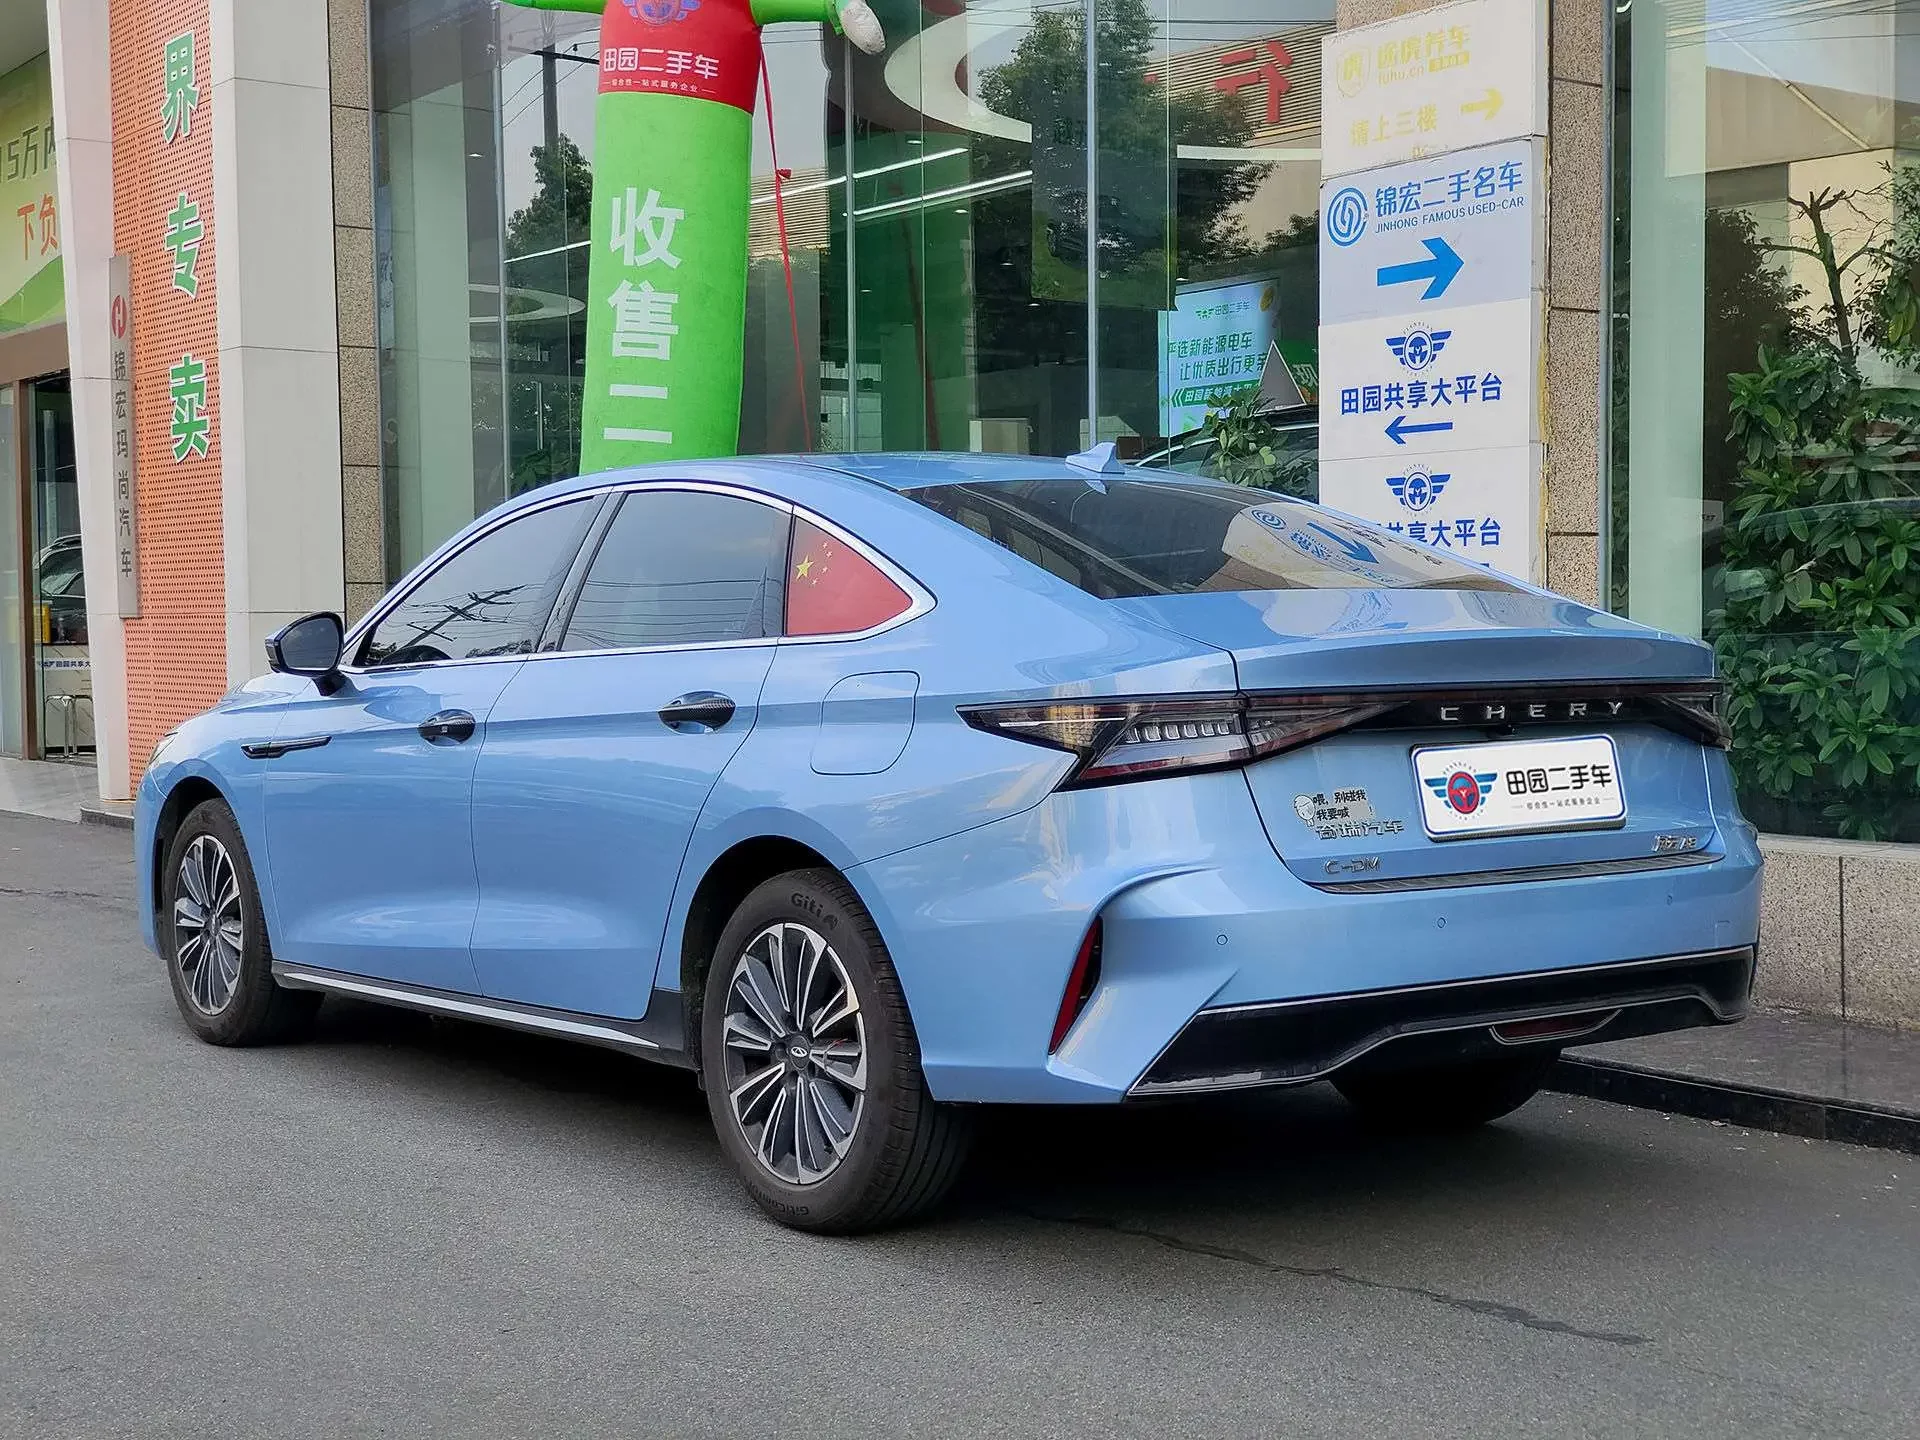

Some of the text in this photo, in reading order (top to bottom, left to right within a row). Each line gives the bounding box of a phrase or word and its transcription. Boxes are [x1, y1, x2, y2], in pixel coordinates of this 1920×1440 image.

[603, 47, 720, 79] 田园二手车
[1375, 161, 1523, 217] 锦宏二手名车
[1375, 196, 1524, 234] JINHONG FAMOUS USED-CAR
[161, 32, 212, 464] 界专卖
[1341, 372, 1503, 415] 田园共享大平台
[1440, 701, 1623, 721] CHERY
[1506, 764, 1612, 795] 田园二手车
[1316, 820, 1405, 841] 奇瑞汽车
[791, 892, 824, 918] Giti
